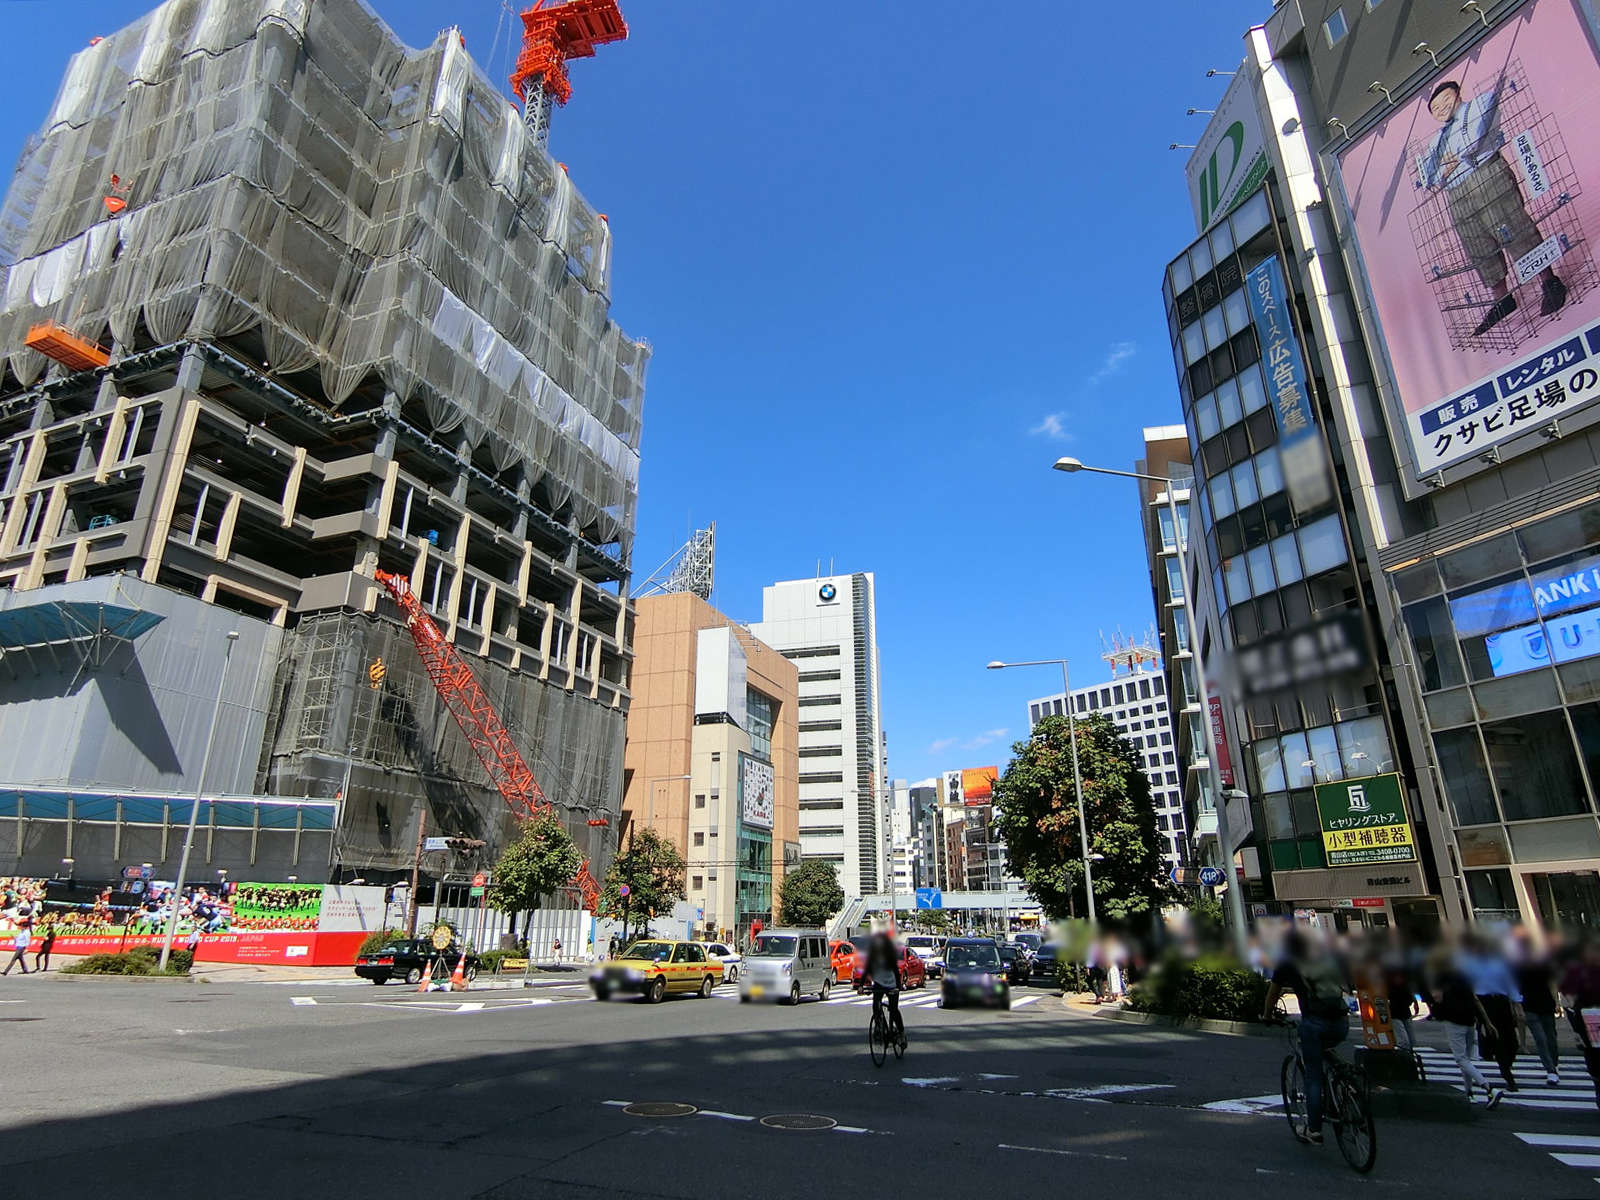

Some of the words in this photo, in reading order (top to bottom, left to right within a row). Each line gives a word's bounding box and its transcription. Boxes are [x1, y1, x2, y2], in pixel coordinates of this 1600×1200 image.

[1180, 265, 1239, 320] 整骨院
[1257, 267, 1307, 437] このスペース広告募集
[1506, 349, 1576, 391] レンタル
[1434, 368, 1598, 457] クサビ足場の
[1437, 394, 1480, 425] 販売
[1329, 827, 1406, 848] 小型補聴器
[1202, 871, 1217, 881] 418
[151, 936, 177, 944] RUGY
[178, 935, 203, 944] WOD
[204, 935, 219, 943] CUP
